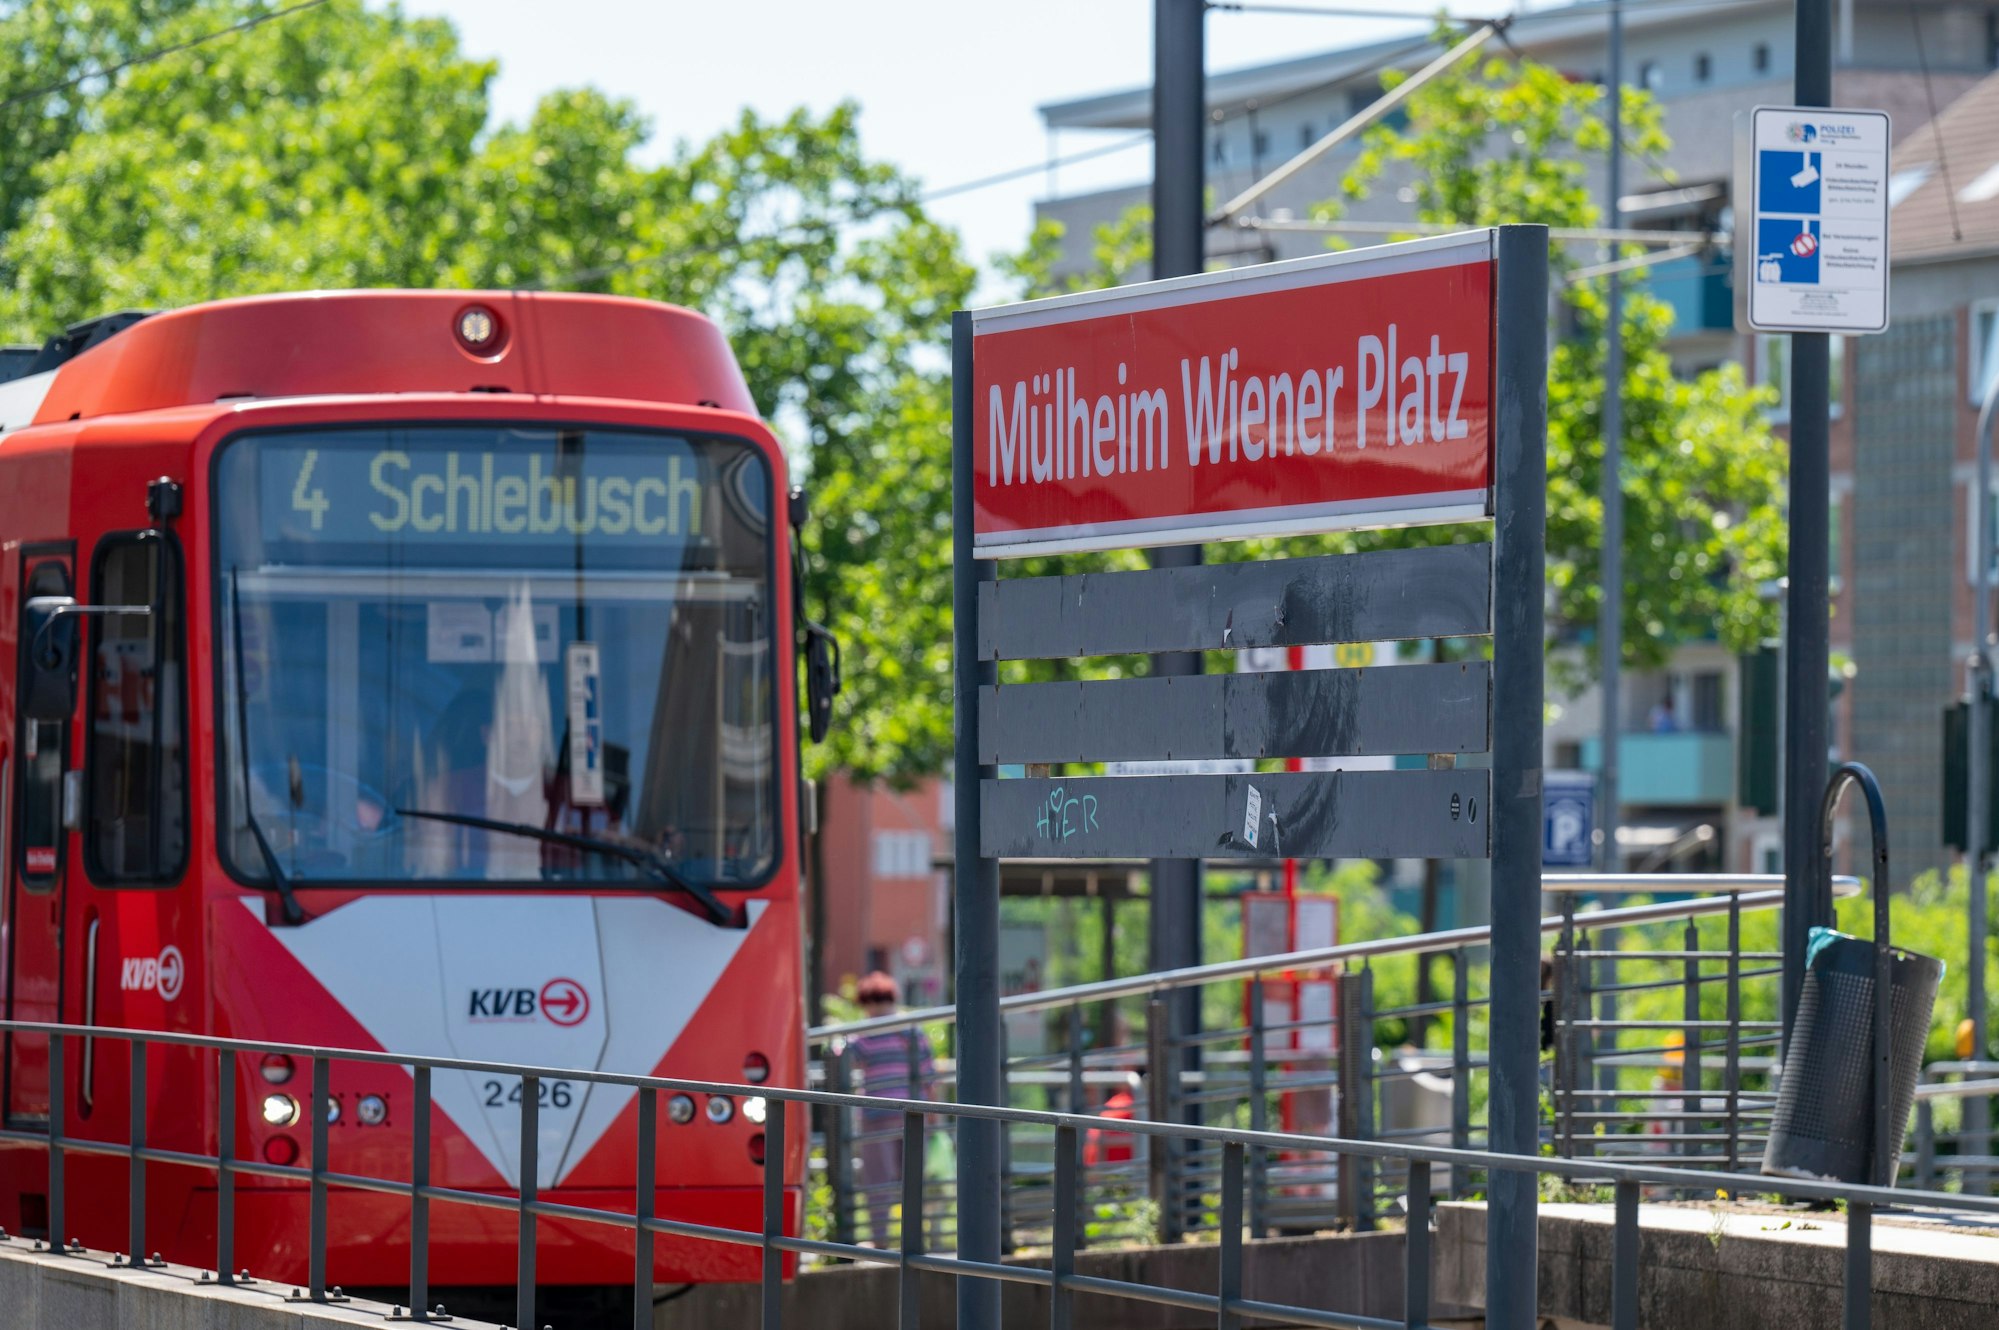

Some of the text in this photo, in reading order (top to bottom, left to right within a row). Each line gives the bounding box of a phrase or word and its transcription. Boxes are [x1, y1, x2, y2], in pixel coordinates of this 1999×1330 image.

[1820, 124, 1855, 134] POLIZEI
[989, 323, 1468, 487] Mülheim Wiener Platz
[291, 449, 701, 535] 4 Schlebusch
[1554, 813, 1582, 855] P
[120, 957, 157, 990] KVB
[468, 989, 537, 1016] KVB
